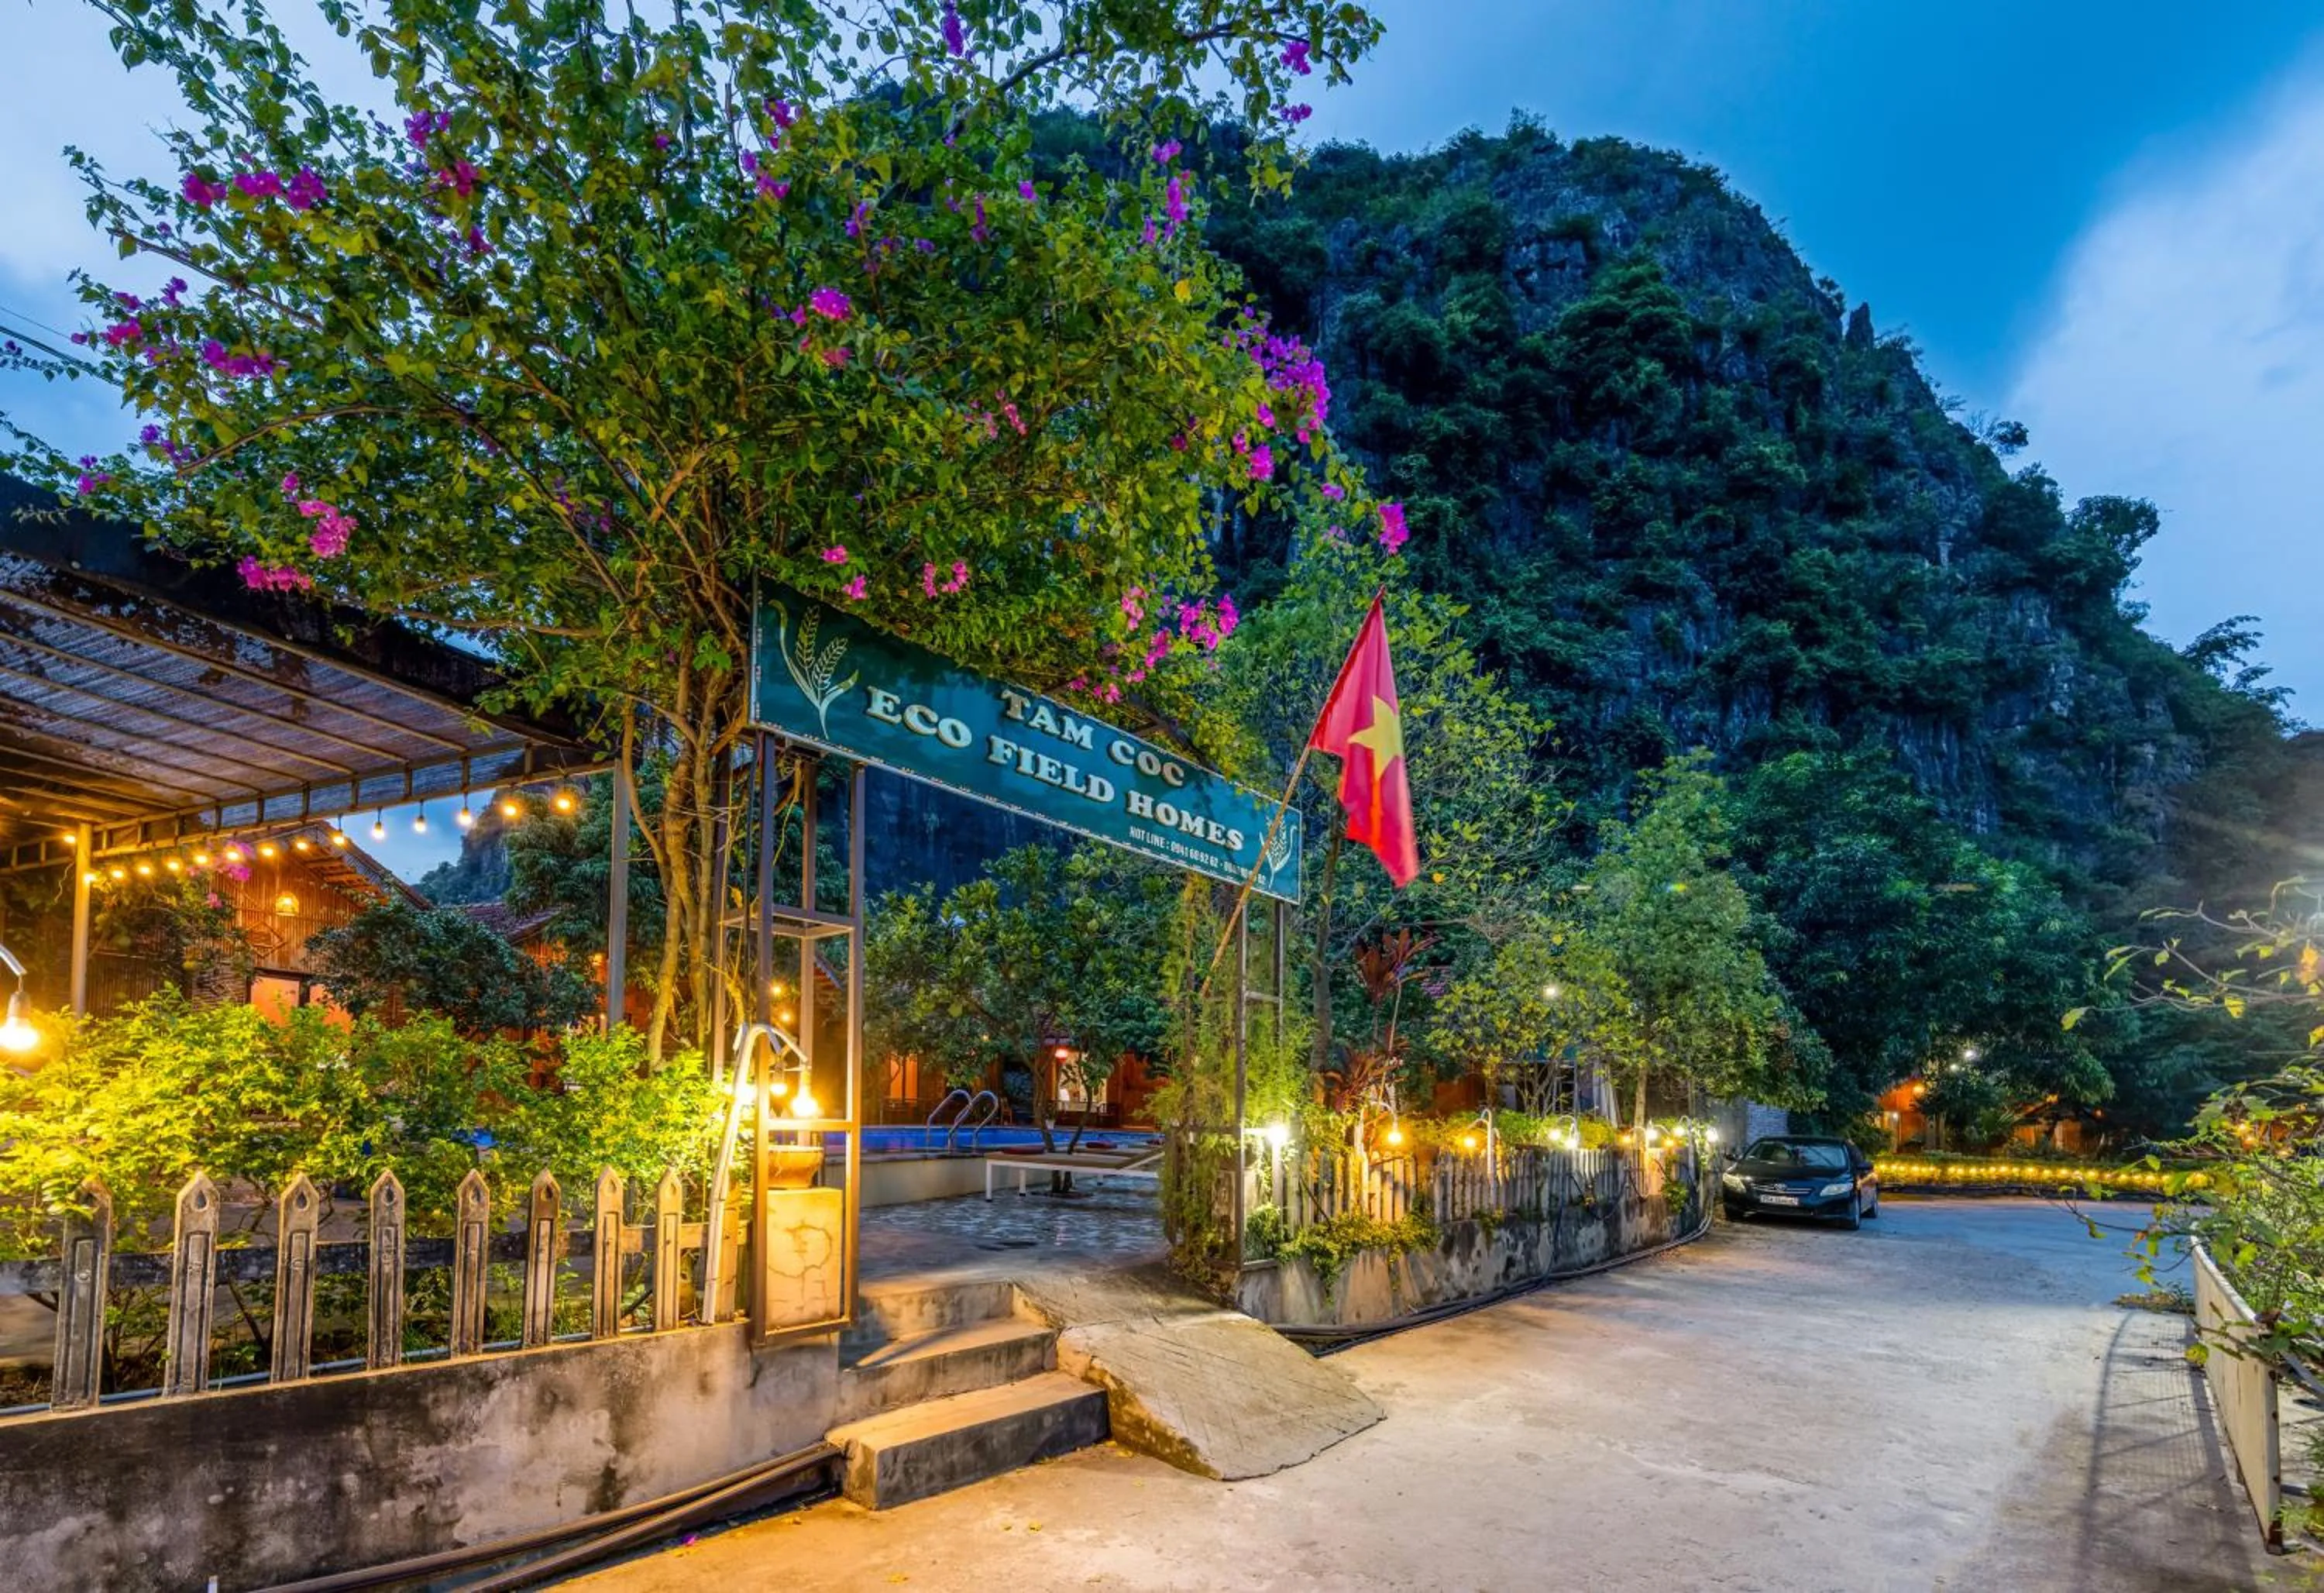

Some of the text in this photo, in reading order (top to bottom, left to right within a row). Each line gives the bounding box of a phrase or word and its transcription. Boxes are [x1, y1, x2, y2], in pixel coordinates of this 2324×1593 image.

[866, 685, 1245, 852] ECO FIELD HOMES
[1001, 689, 1185, 787] TAM COC
